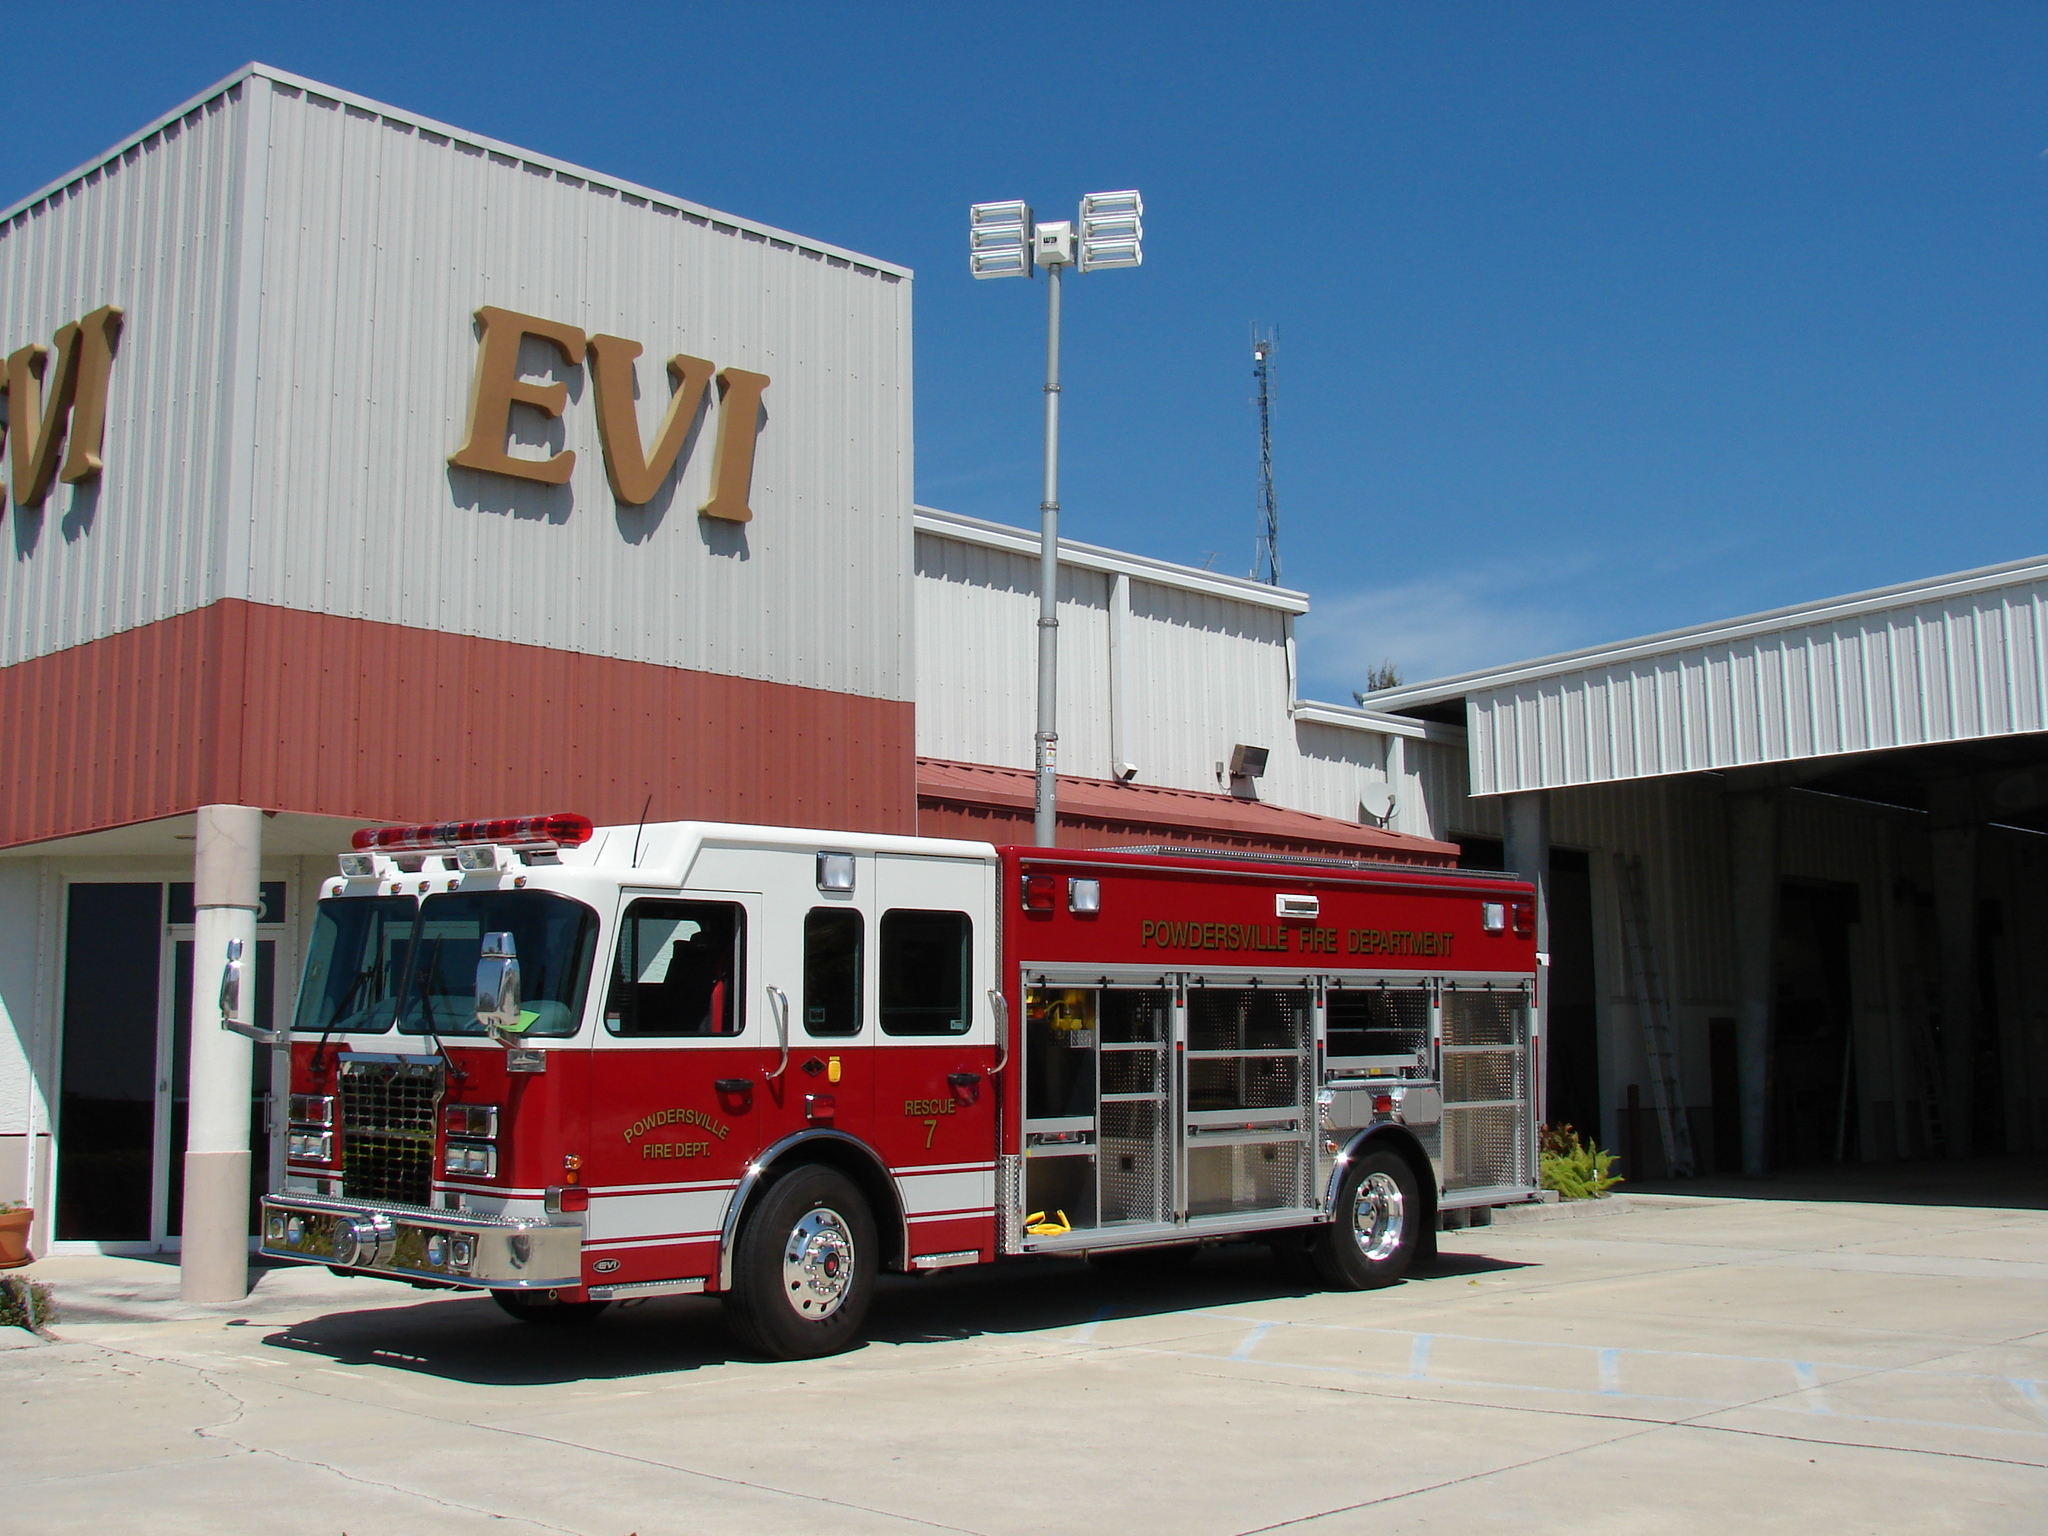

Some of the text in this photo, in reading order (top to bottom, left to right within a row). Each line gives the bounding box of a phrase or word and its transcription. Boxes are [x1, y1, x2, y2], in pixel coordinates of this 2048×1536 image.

[0, 304, 123, 506] VI
[447, 305, 771, 523] EVI
[1142, 919, 1454, 956] POWDERSVILLE FIRE DEPARTMENT
[904, 1098, 956, 1116] RESCUE
[623, 1108, 730, 1145] POWDERSVILLE
[924, 1119, 938, 1149] 7
[643, 1141, 711, 1159] FIRE DEPT.
